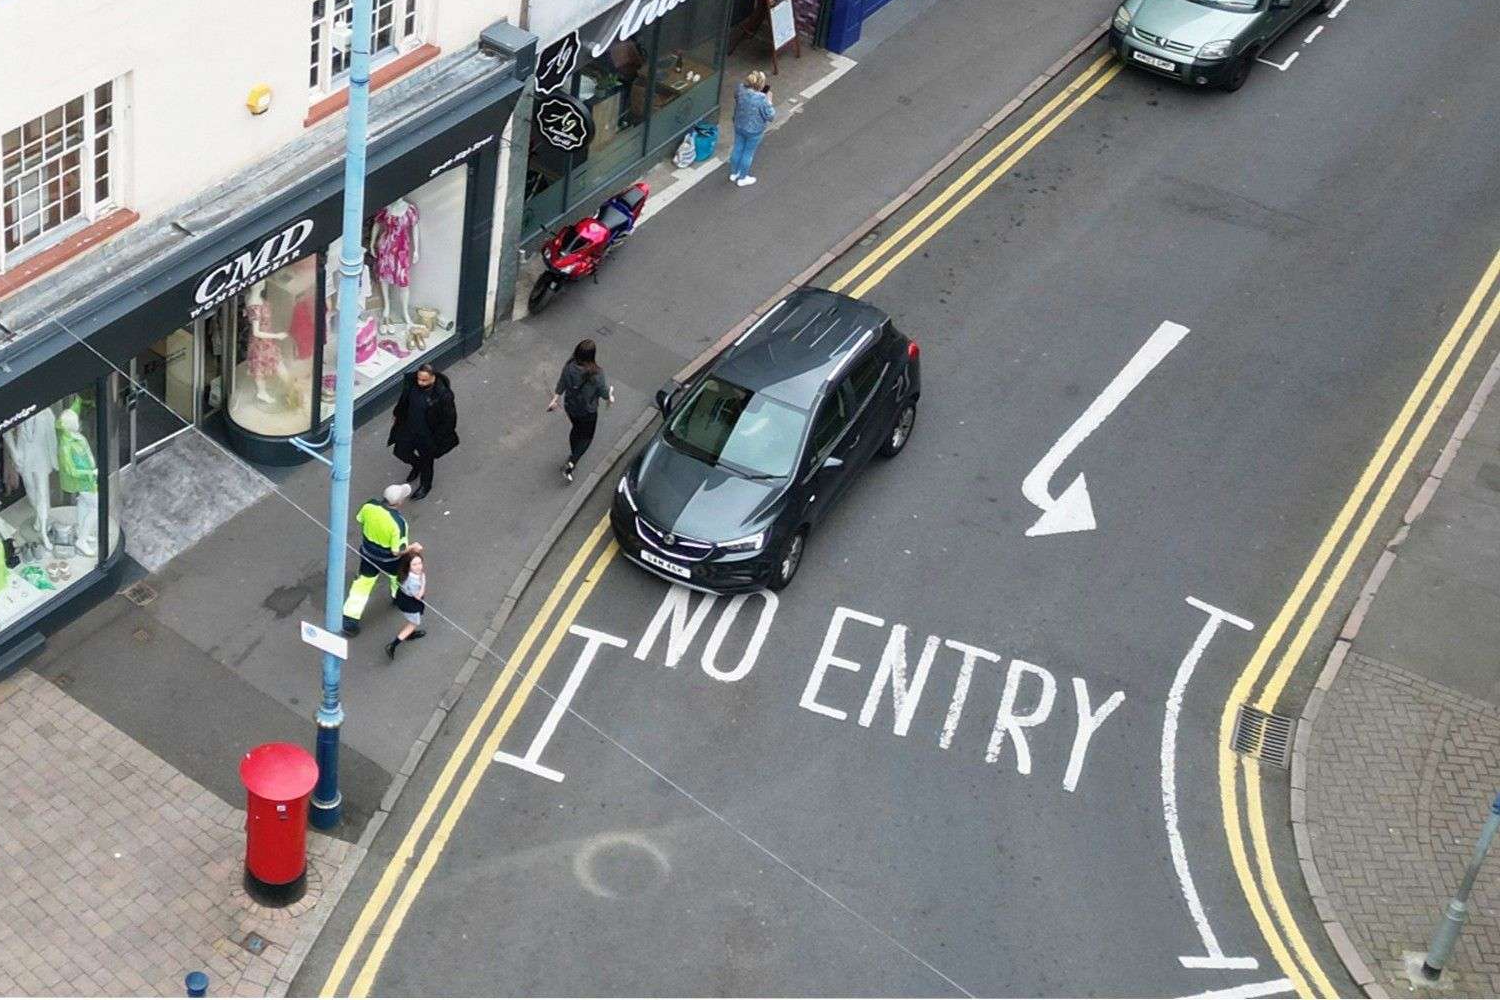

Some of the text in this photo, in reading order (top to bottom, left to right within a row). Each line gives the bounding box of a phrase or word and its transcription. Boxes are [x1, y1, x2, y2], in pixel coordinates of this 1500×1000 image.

[190, 249, 301, 318] WOMENSWEAR
[195, 219, 314, 304] CMD
[633, 584, 1125, 792] NO ENTRY
